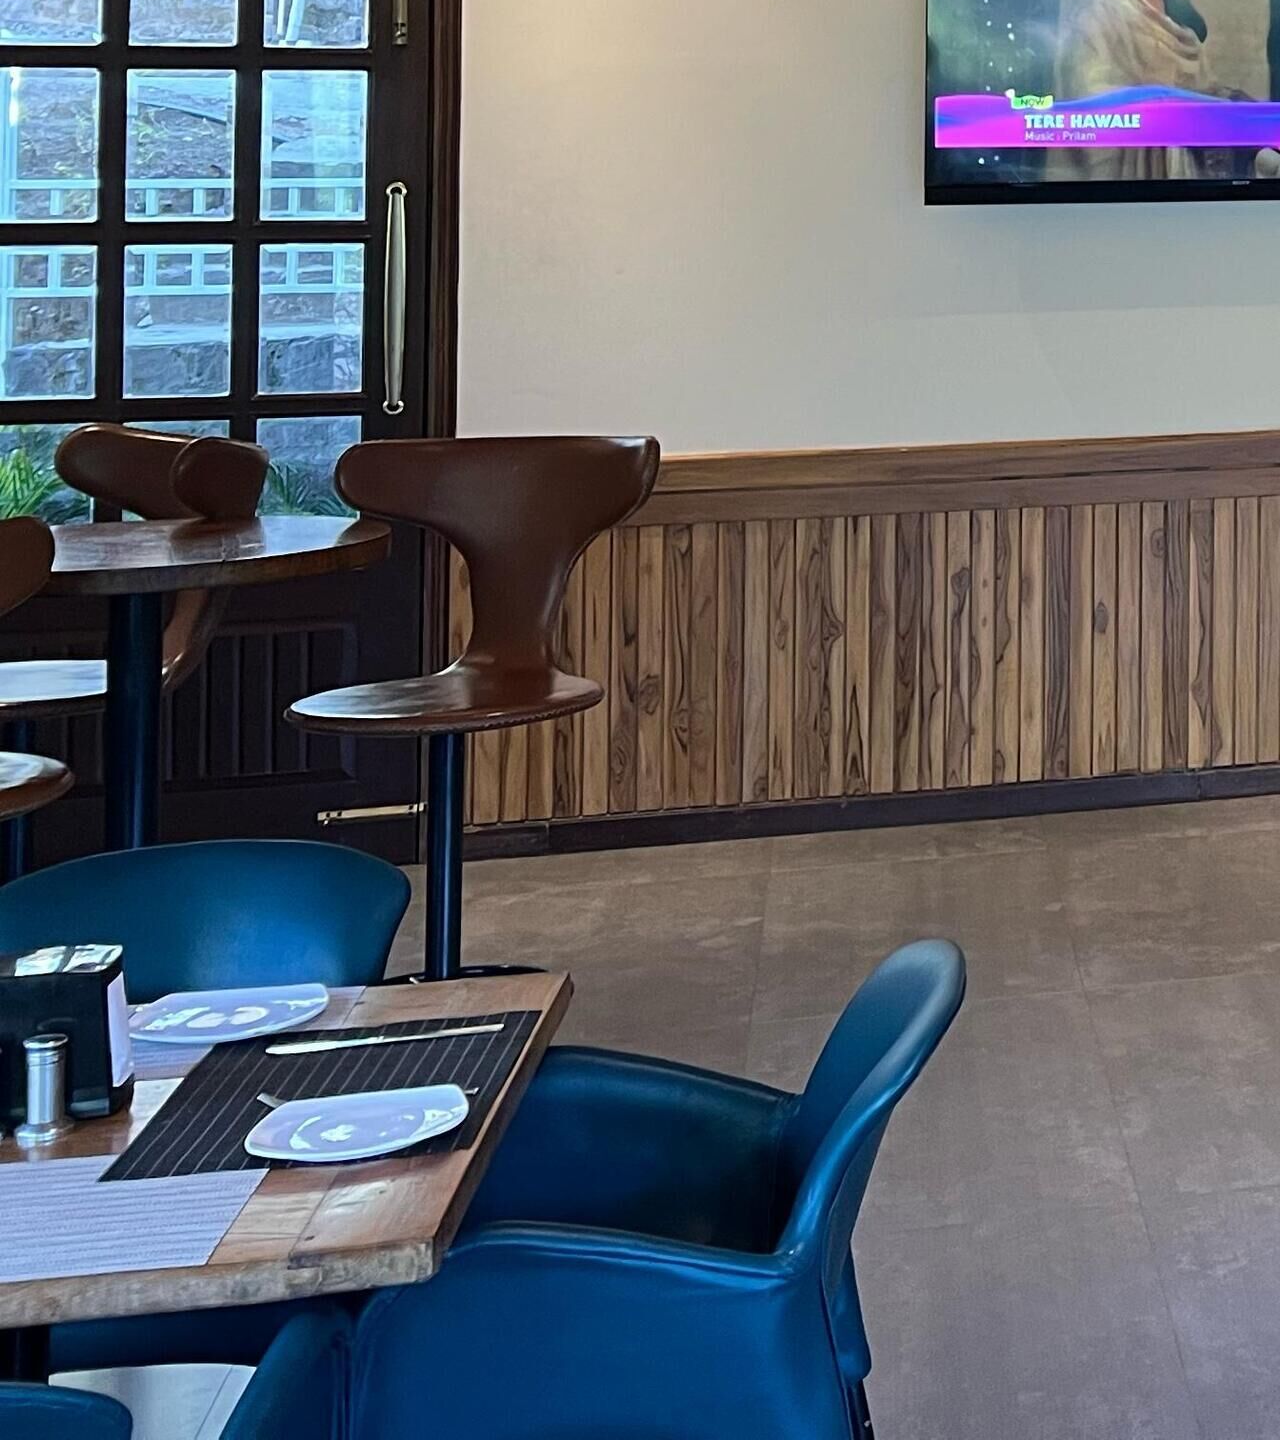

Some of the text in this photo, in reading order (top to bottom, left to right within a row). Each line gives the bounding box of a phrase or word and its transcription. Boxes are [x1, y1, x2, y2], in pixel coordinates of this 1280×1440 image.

[1020, 98, 1045, 107] NOW
[1025, 114, 1141, 129] TERE HAWALE
[1024, 131, 1055, 141] Music
